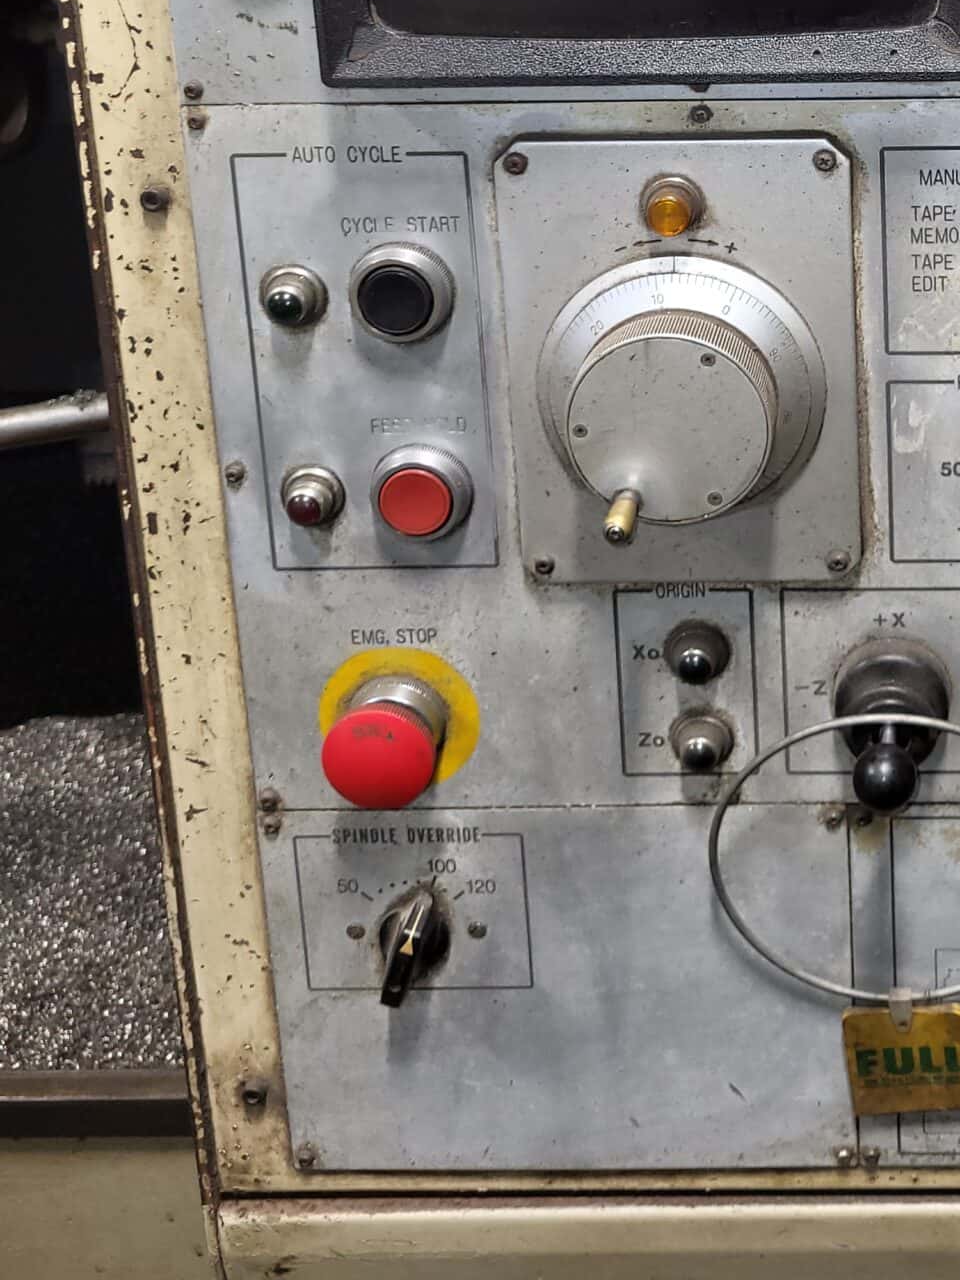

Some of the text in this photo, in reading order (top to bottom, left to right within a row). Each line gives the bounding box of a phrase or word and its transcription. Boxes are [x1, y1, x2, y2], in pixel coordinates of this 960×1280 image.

[292, 146, 402, 164] AUTO CYCLE
[408, 216, 461, 233] START
[911, 254, 954, 270] TAPE
[912, 276, 948, 293] EDIT
[651, 294, 665, 305] 10
[655, 582, 706, 599] ORIGIN
[396, 628, 438, 644] STOP
[331, 827, 481, 845] SPINDLE OVERRIDE
[428, 859, 456, 873] 100
[338, 879, 358, 893] 50
[467, 879, 496, 893] 120
